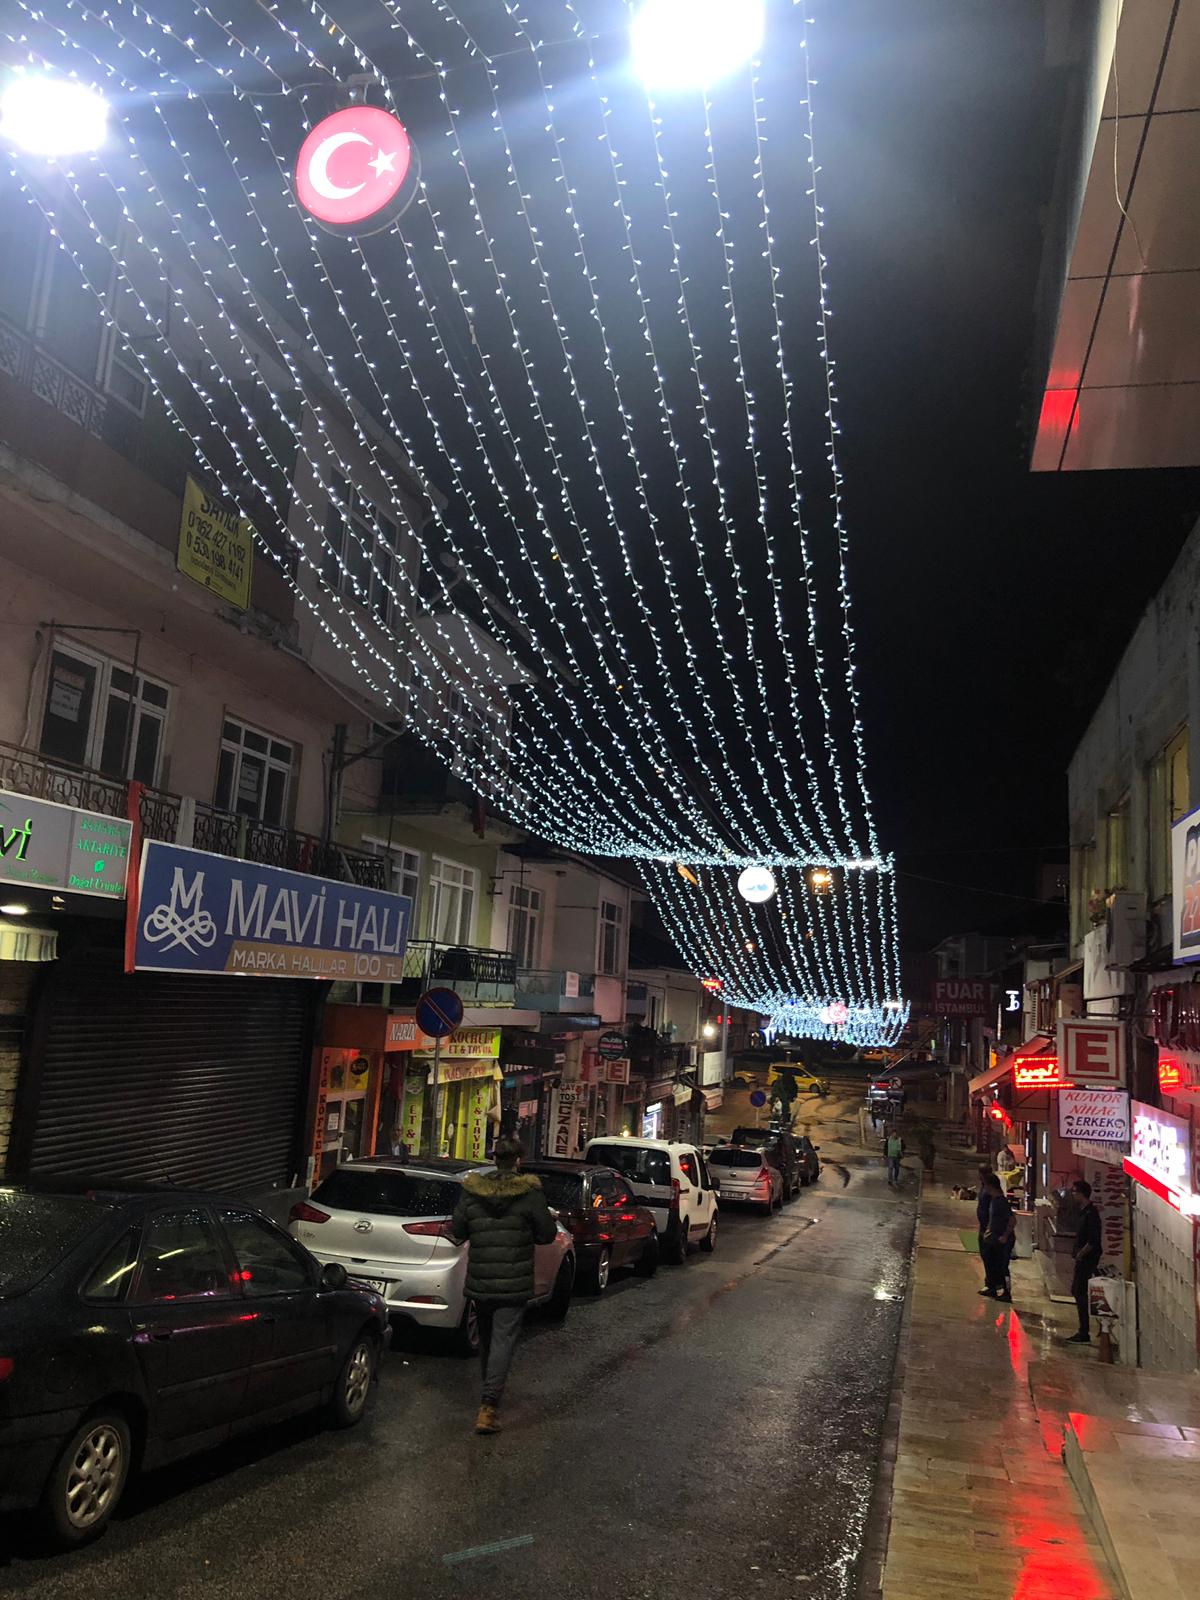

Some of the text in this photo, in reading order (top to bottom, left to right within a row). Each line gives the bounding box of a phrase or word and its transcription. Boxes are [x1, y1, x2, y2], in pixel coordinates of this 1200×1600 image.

[224, 878, 405, 954] MAVİ HALI
[232, 949, 398, 978] MARKA HALILAR 100 TL
[935, 982, 985, 999] FUAR
[1075, 1032, 1109, 1073] E
[609, 1062, 624, 1079] E
[560, 1093, 581, 1101] TOST
[555, 1101, 573, 1155] CZANE
[1075, 1116, 1115, 1128] ERKEK
